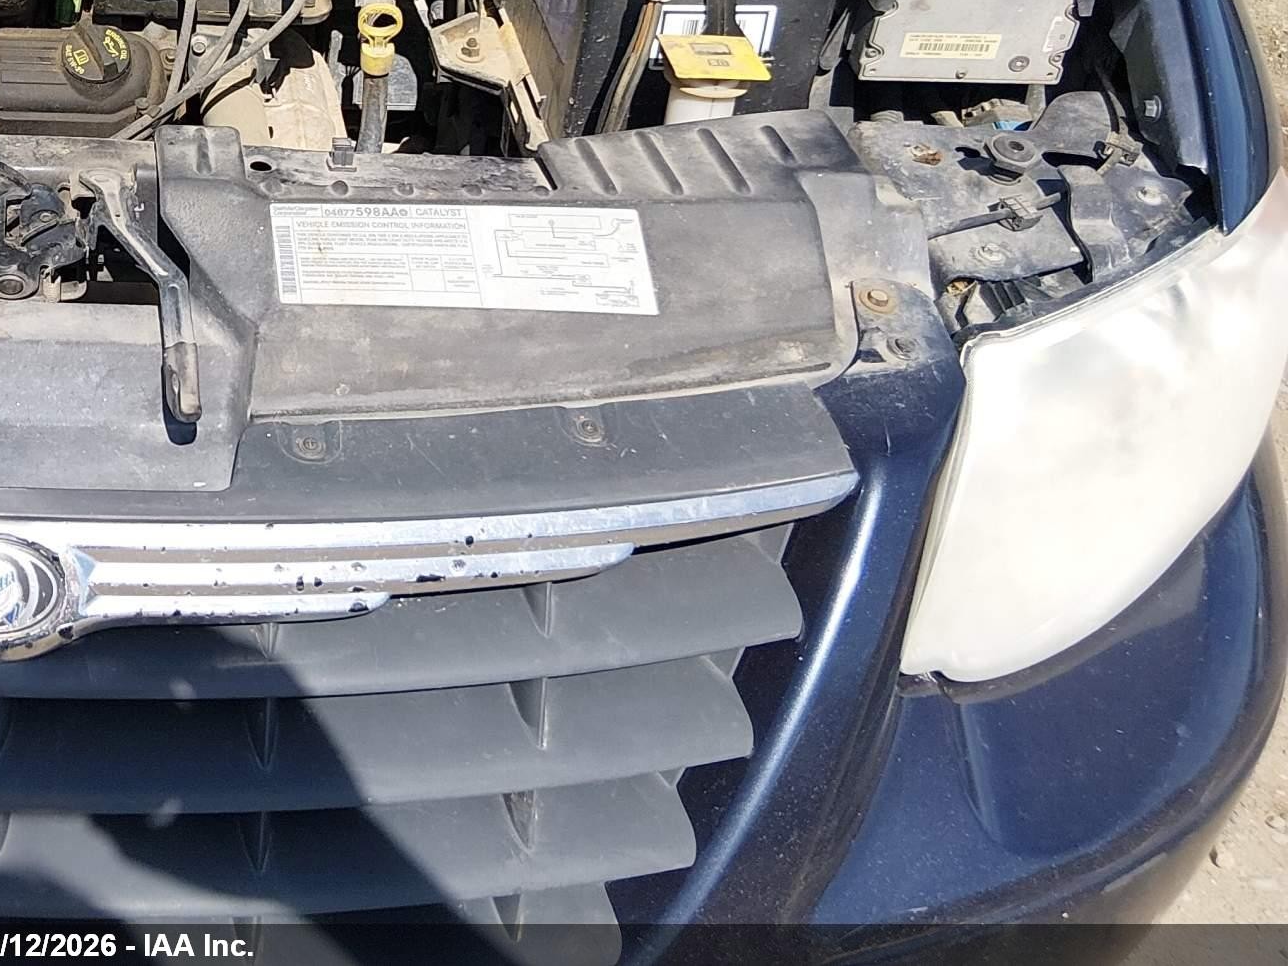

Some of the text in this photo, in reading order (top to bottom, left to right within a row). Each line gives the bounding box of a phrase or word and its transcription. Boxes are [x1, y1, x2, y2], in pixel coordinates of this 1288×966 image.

[415, 208, 462, 217] CATALYST
[295, 220, 466, 230] VEHICLE EMISSION CONTROL INFORMATION
